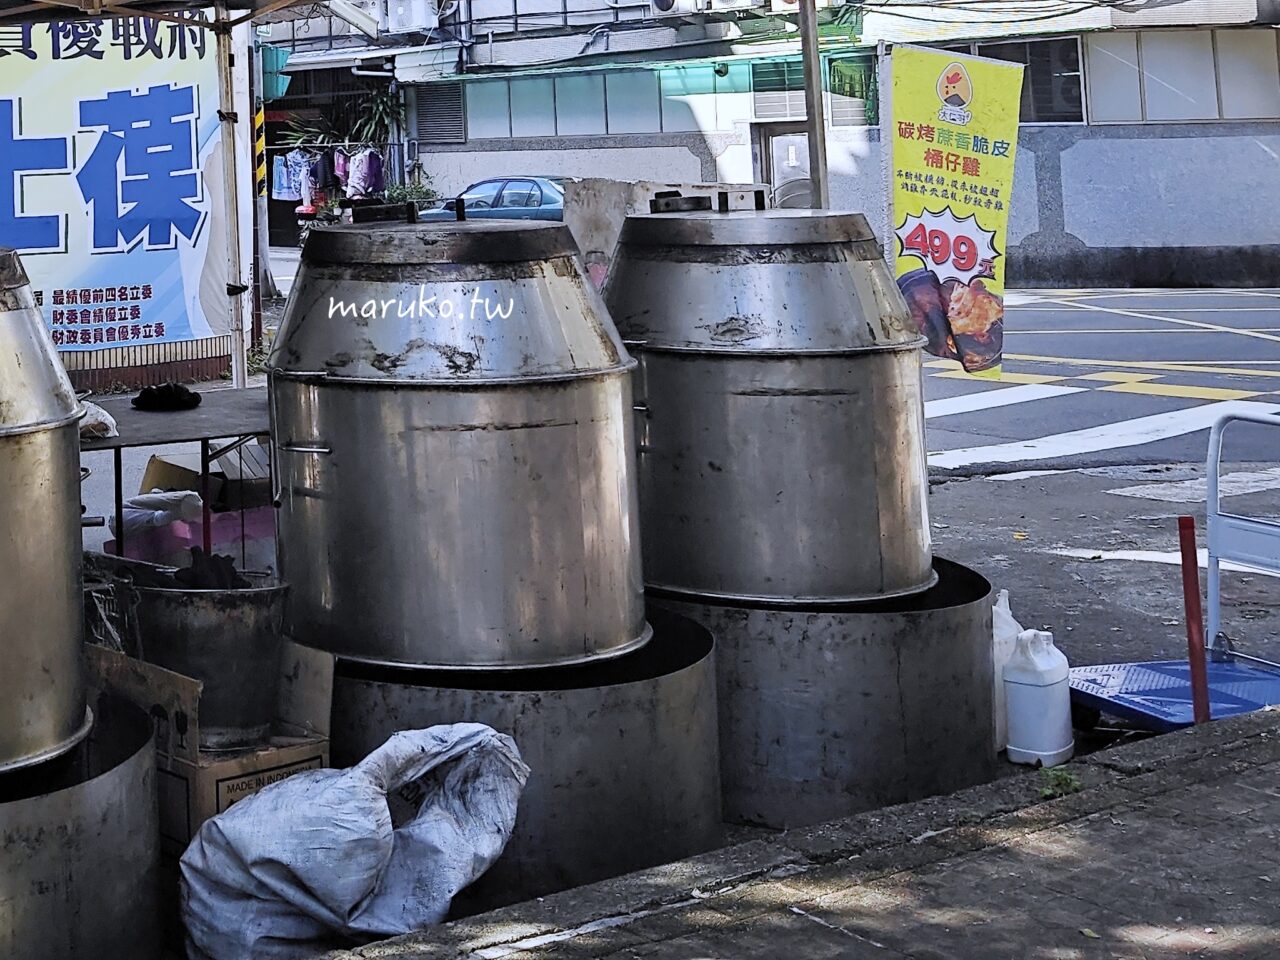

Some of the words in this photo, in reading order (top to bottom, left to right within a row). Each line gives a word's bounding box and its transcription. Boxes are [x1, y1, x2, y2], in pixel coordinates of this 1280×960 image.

[897, 121, 1011, 158] 碳烤蔗香脆皮
[923, 147, 981, 177] 桶仔雞
[904, 222, 978, 271] 499
[52, 284, 152, 306] 最績優前四名立委
[52, 304, 141, 326] 財委會績優立委
[51, 322, 166, 346] 財政委員會優秀立委
[226, 780, 253, 794] MADE
